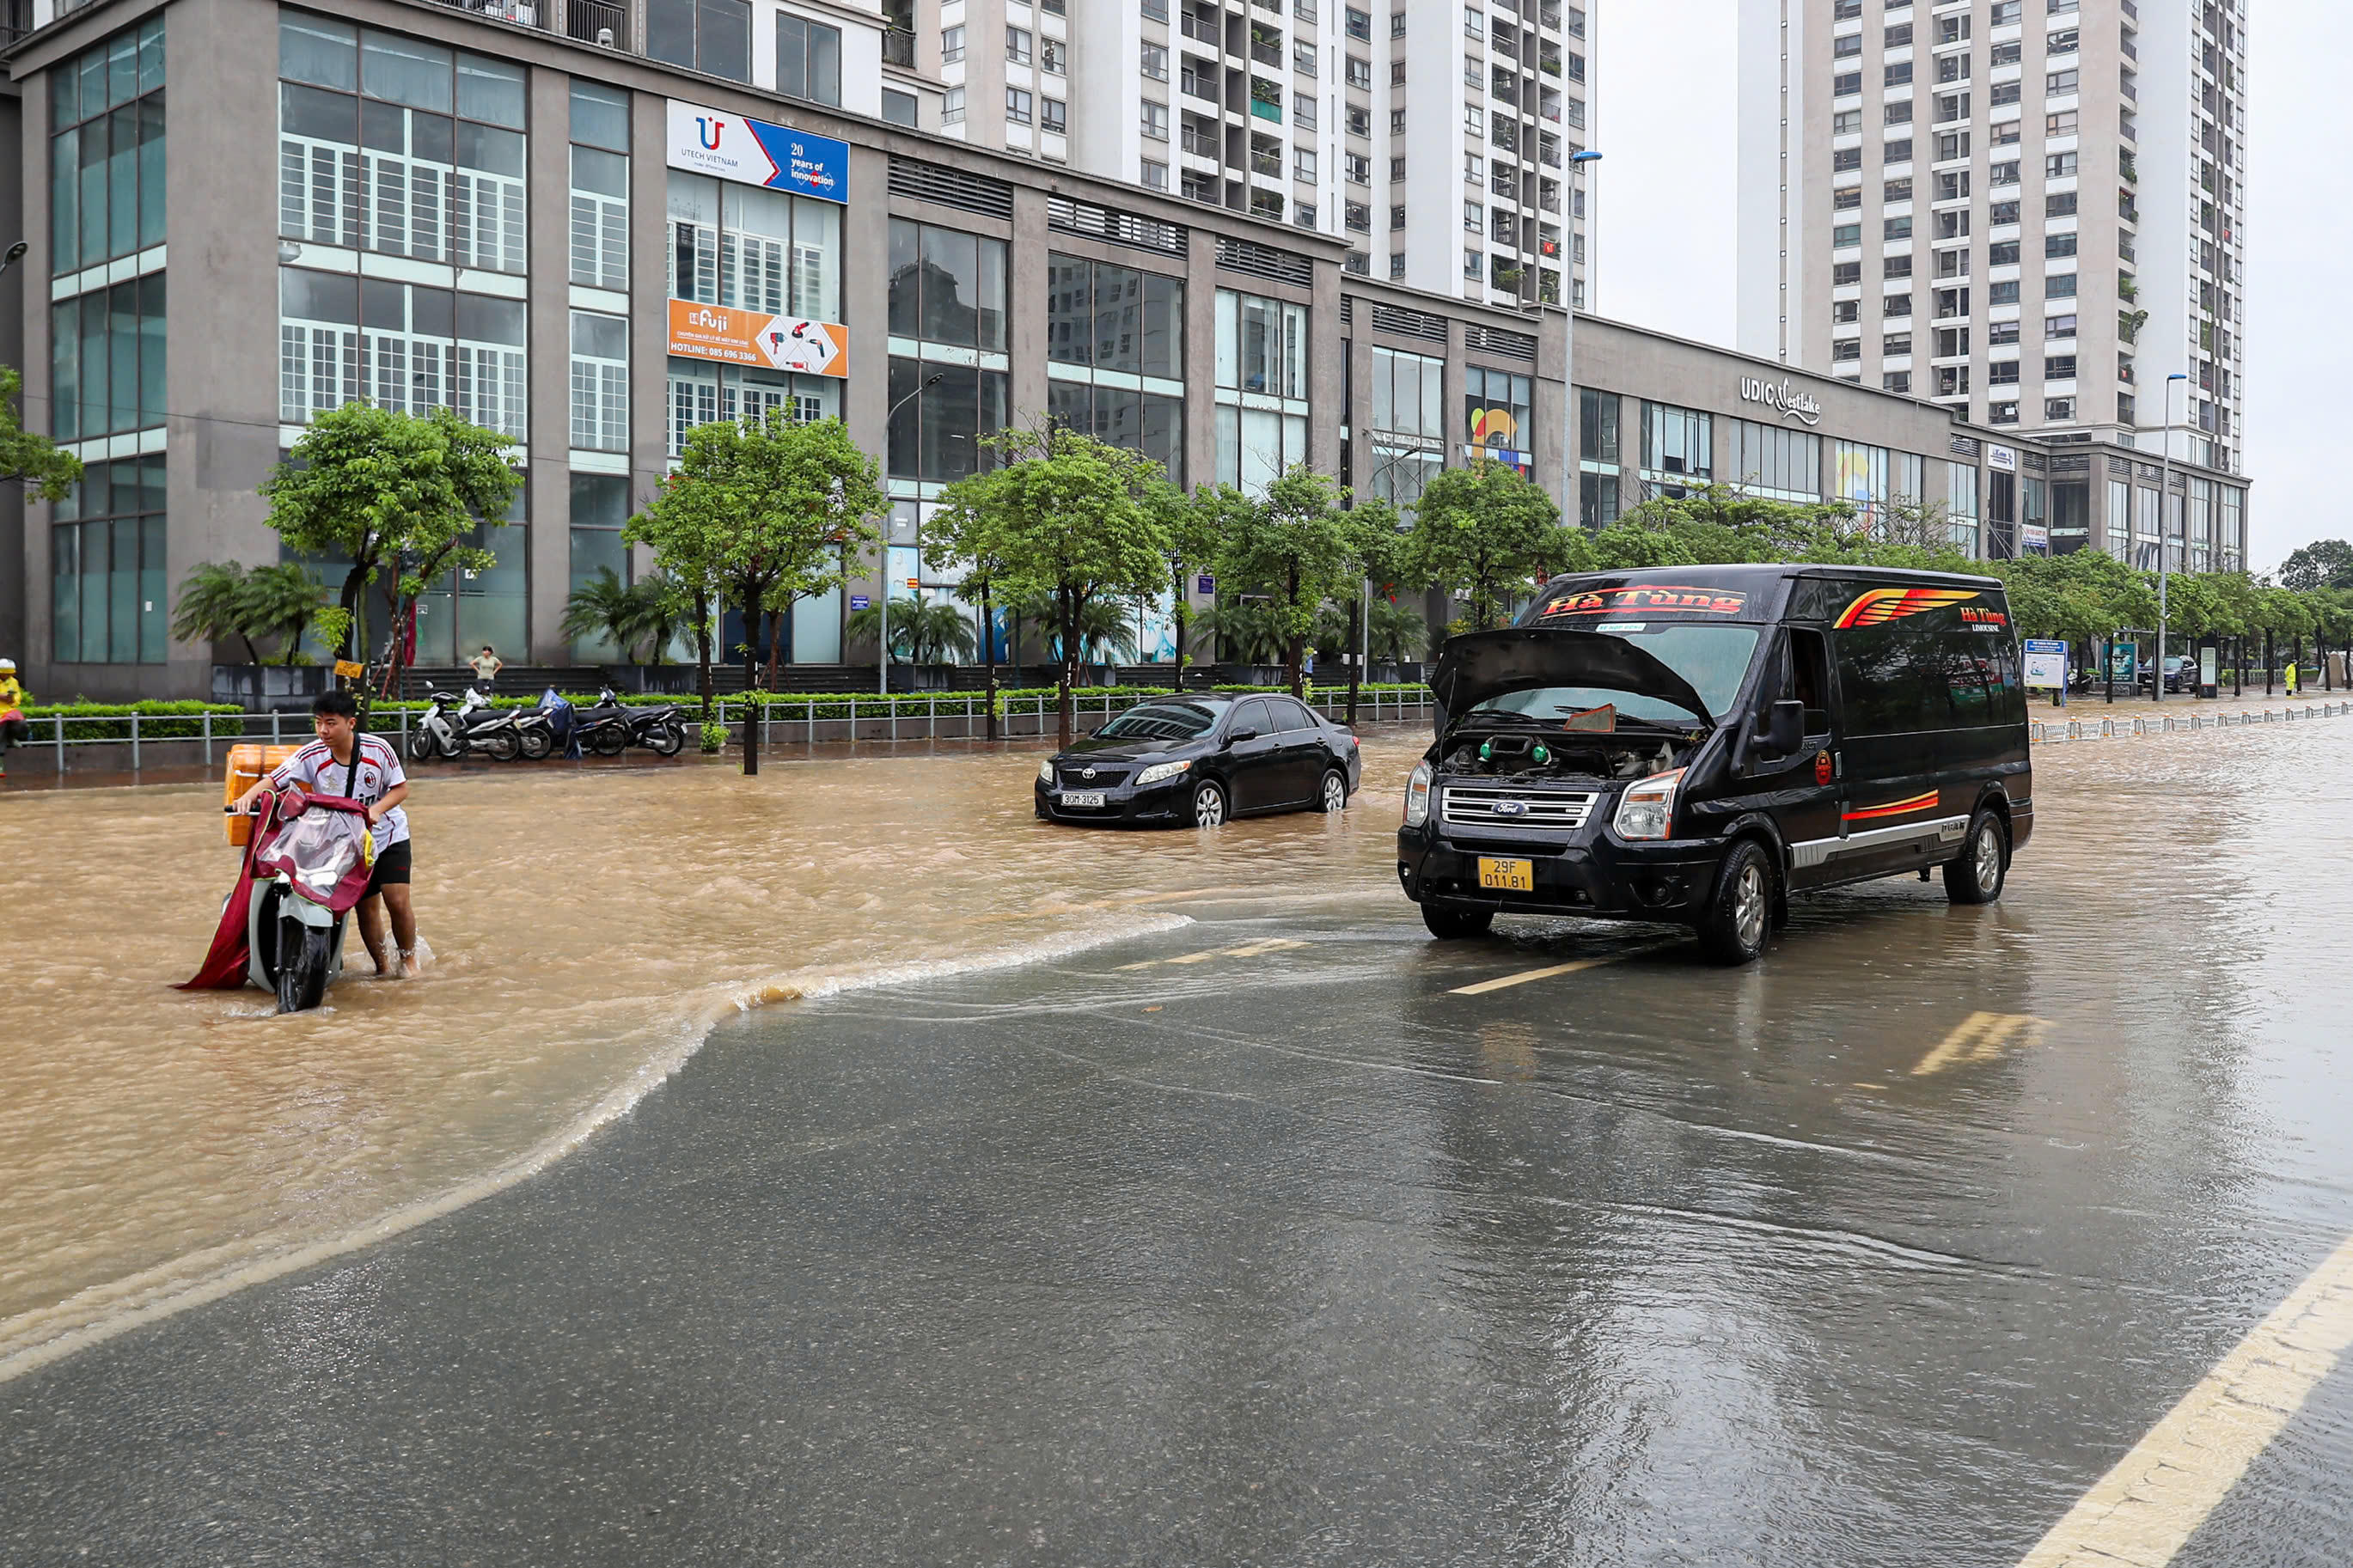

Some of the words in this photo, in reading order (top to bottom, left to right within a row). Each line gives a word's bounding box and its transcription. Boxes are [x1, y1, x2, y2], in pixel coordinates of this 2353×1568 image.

[681, 148, 705, 160] UTECH
[706, 154, 738, 167] VIETNAM
[791, 143, 804, 156] 20
[791, 158, 813, 169] years
[815, 162, 823, 171] of
[791, 168, 834, 186] innovation
[671, 342, 707, 355] HOTLINE:
[709, 347, 722, 357] 085
[724, 350, 737, 358] 696
[739, 352, 756, 361] 3366
[1741, 377, 1774, 405] UDIC
[1541, 595, 1604, 615] Hà
[1616, 589, 1745, 613] Tùng
[1959, 607, 1978, 622] Hà
[1977, 607, 2007, 626] Tùng
[1497, 803, 1519, 813] Ford
[1494, 861, 1516, 873] 29F
[1485, 874, 1525, 888] 011.81
